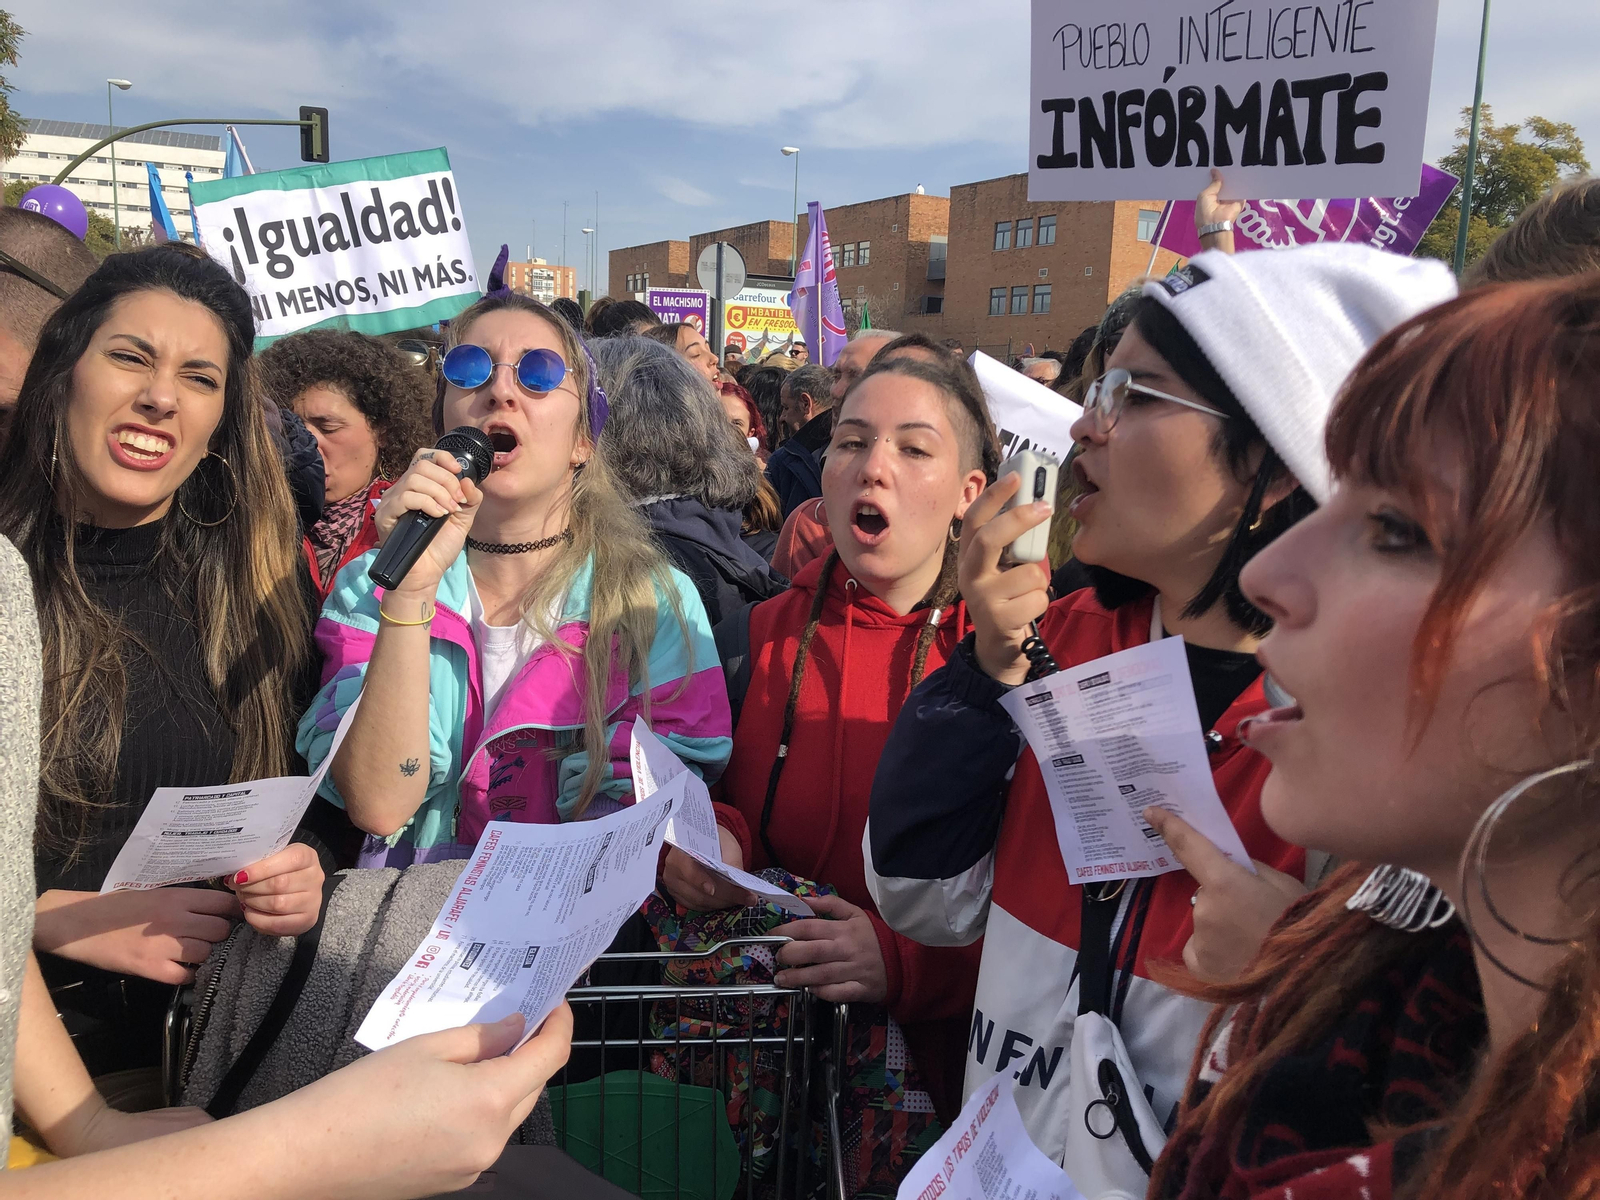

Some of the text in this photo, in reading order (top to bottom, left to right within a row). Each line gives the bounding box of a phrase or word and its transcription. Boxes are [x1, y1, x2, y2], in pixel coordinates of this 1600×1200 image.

[1052, 0, 1376, 71] PUEBLO INTELIGENTE
[1036, 66, 1389, 169] INFÓRMATE
[222, 176, 462, 285] ¡Igualdad!
[275, 276, 379, 318] MENOS,
[378, 268, 409, 298] NI
[411, 254, 474, 292] MÁS.
[653, 296, 704, 308] EL MACHISMO
[747, 318, 762, 327] EN
[483, 829, 503, 851] CAFES
[464, 851, 493, 886] FEMINISTAS
[1075, 866, 1094, 878] CAFES
[1094, 862, 1127, 876] FEMINISTAS
[444, 886, 473, 923] ALJARAFE
[943, 1155, 956, 1183] LOS
[952, 1131, 972, 1164] TIPOS
[969, 1118, 979, 1141] DE
[976, 1083, 1000, 1128] VIOLENCIA
